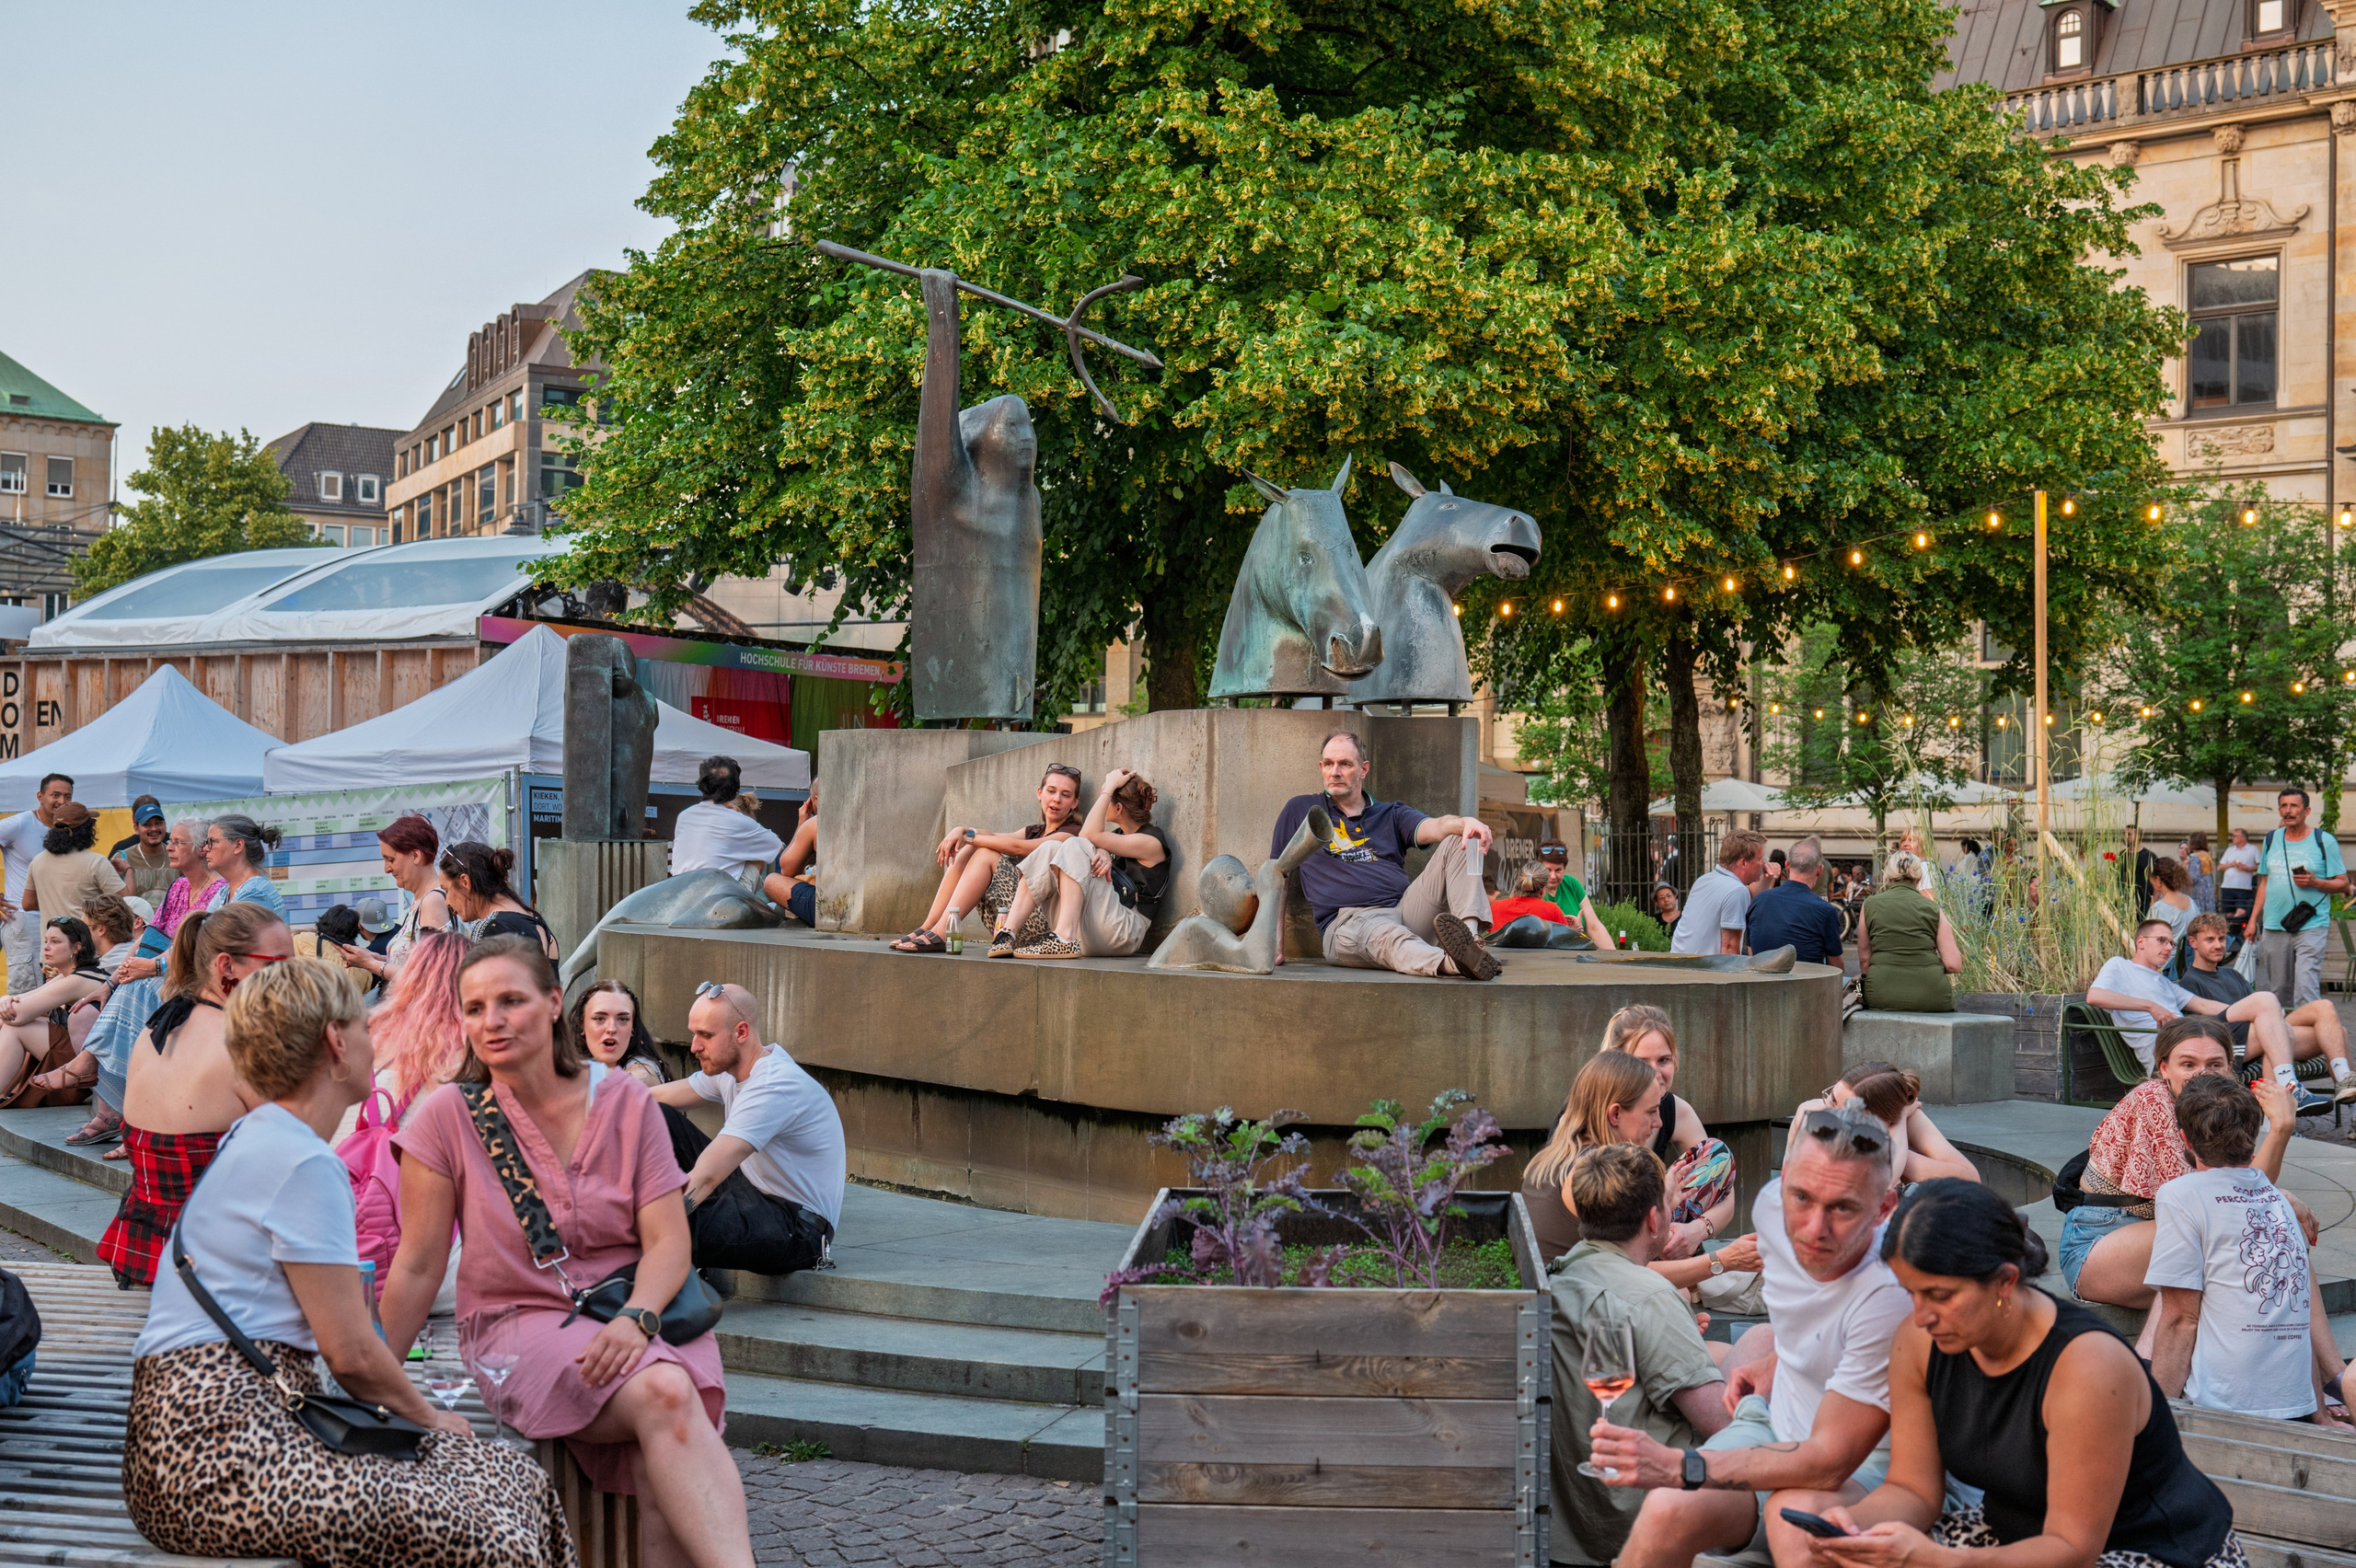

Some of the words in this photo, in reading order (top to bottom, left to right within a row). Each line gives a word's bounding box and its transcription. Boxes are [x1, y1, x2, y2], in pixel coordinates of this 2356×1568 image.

[740, 651, 797, 669] HOCHSCHULE
[798, 657, 814, 671] FÜR
[814, 658, 847, 674] KÜNSTE
[848, 663, 880, 676] BREMEN
[533, 791, 560, 801] KIEKEN,
[533, 801, 551, 811] DORT,
[1505, 837, 1535, 859] BREMER
